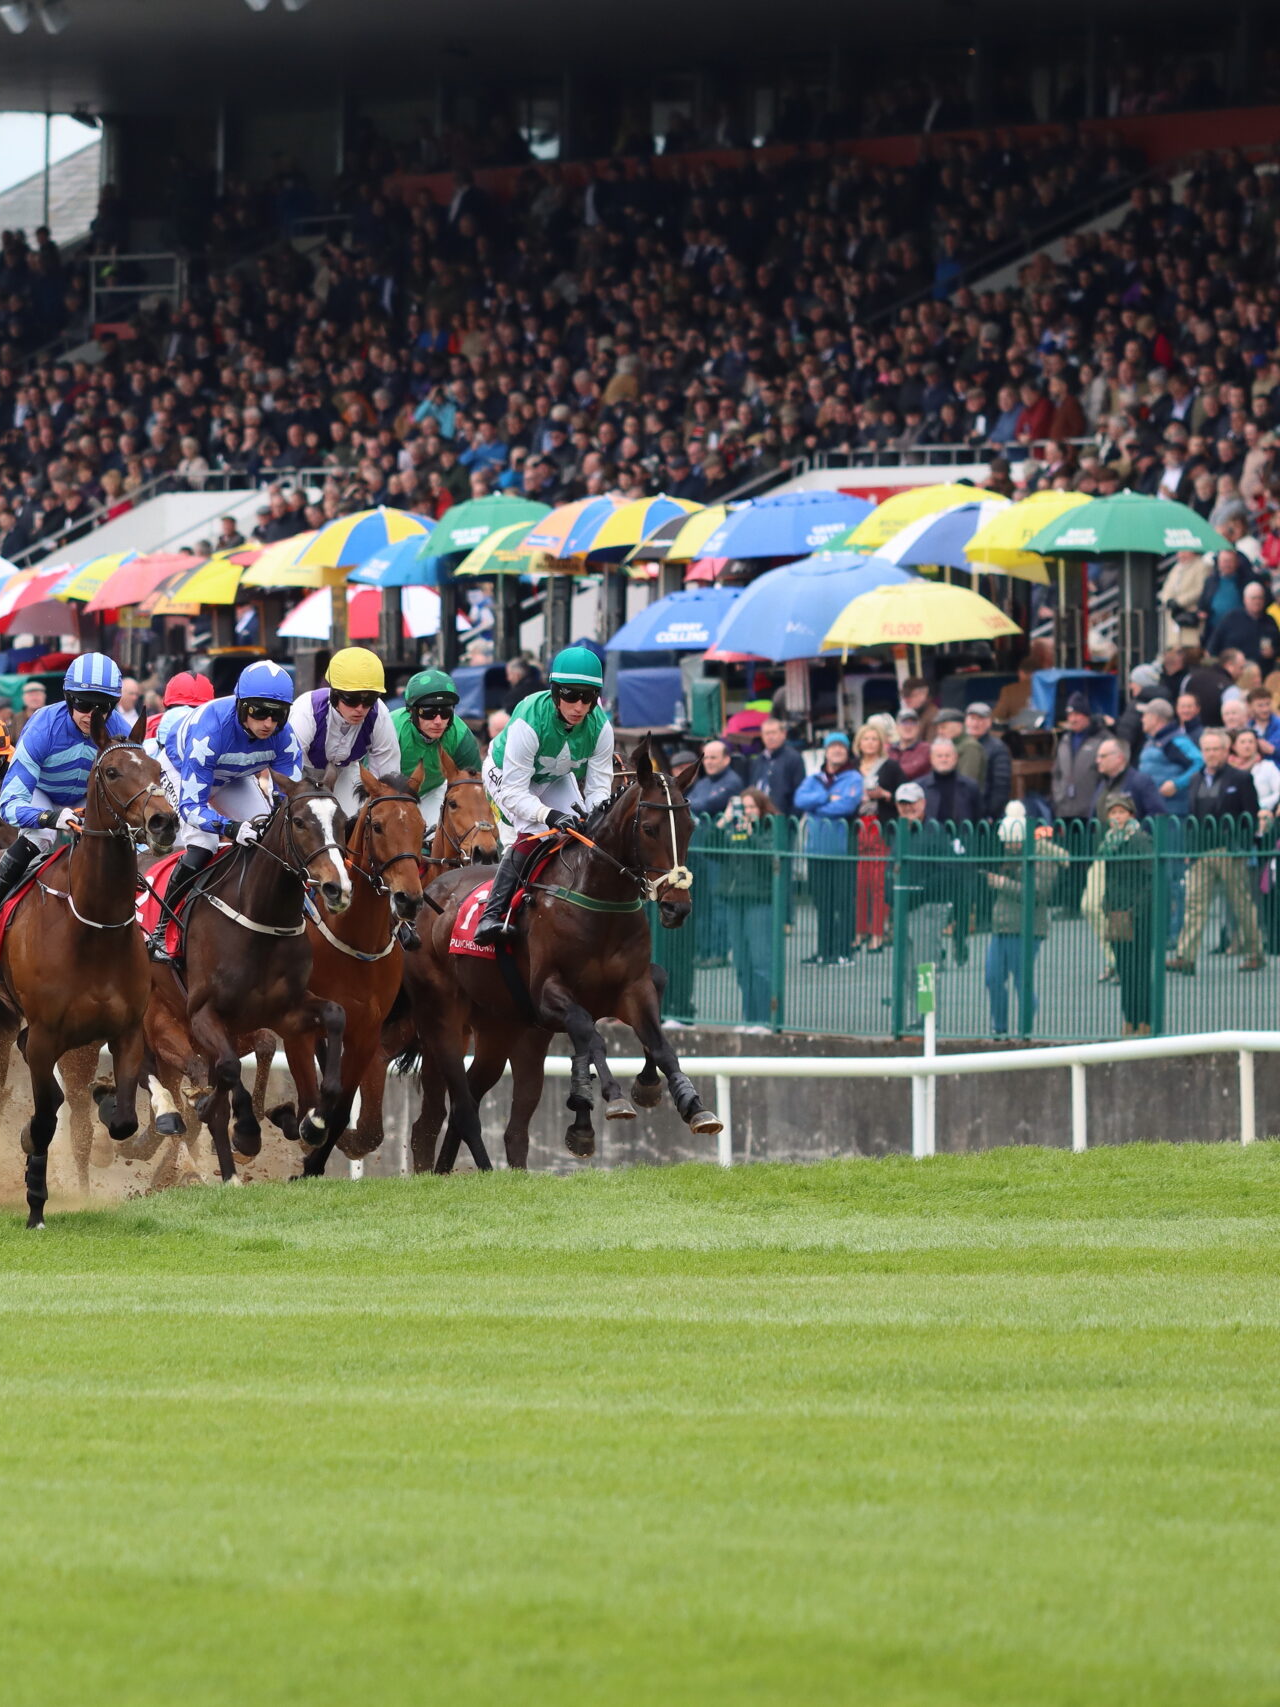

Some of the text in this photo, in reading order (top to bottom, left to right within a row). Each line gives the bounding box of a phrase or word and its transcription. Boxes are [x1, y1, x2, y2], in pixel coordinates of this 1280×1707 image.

[881, 624, 924, 636] FLOOD
[655, 631, 709, 644] COLLINS
[460, 890, 489, 930] 1
